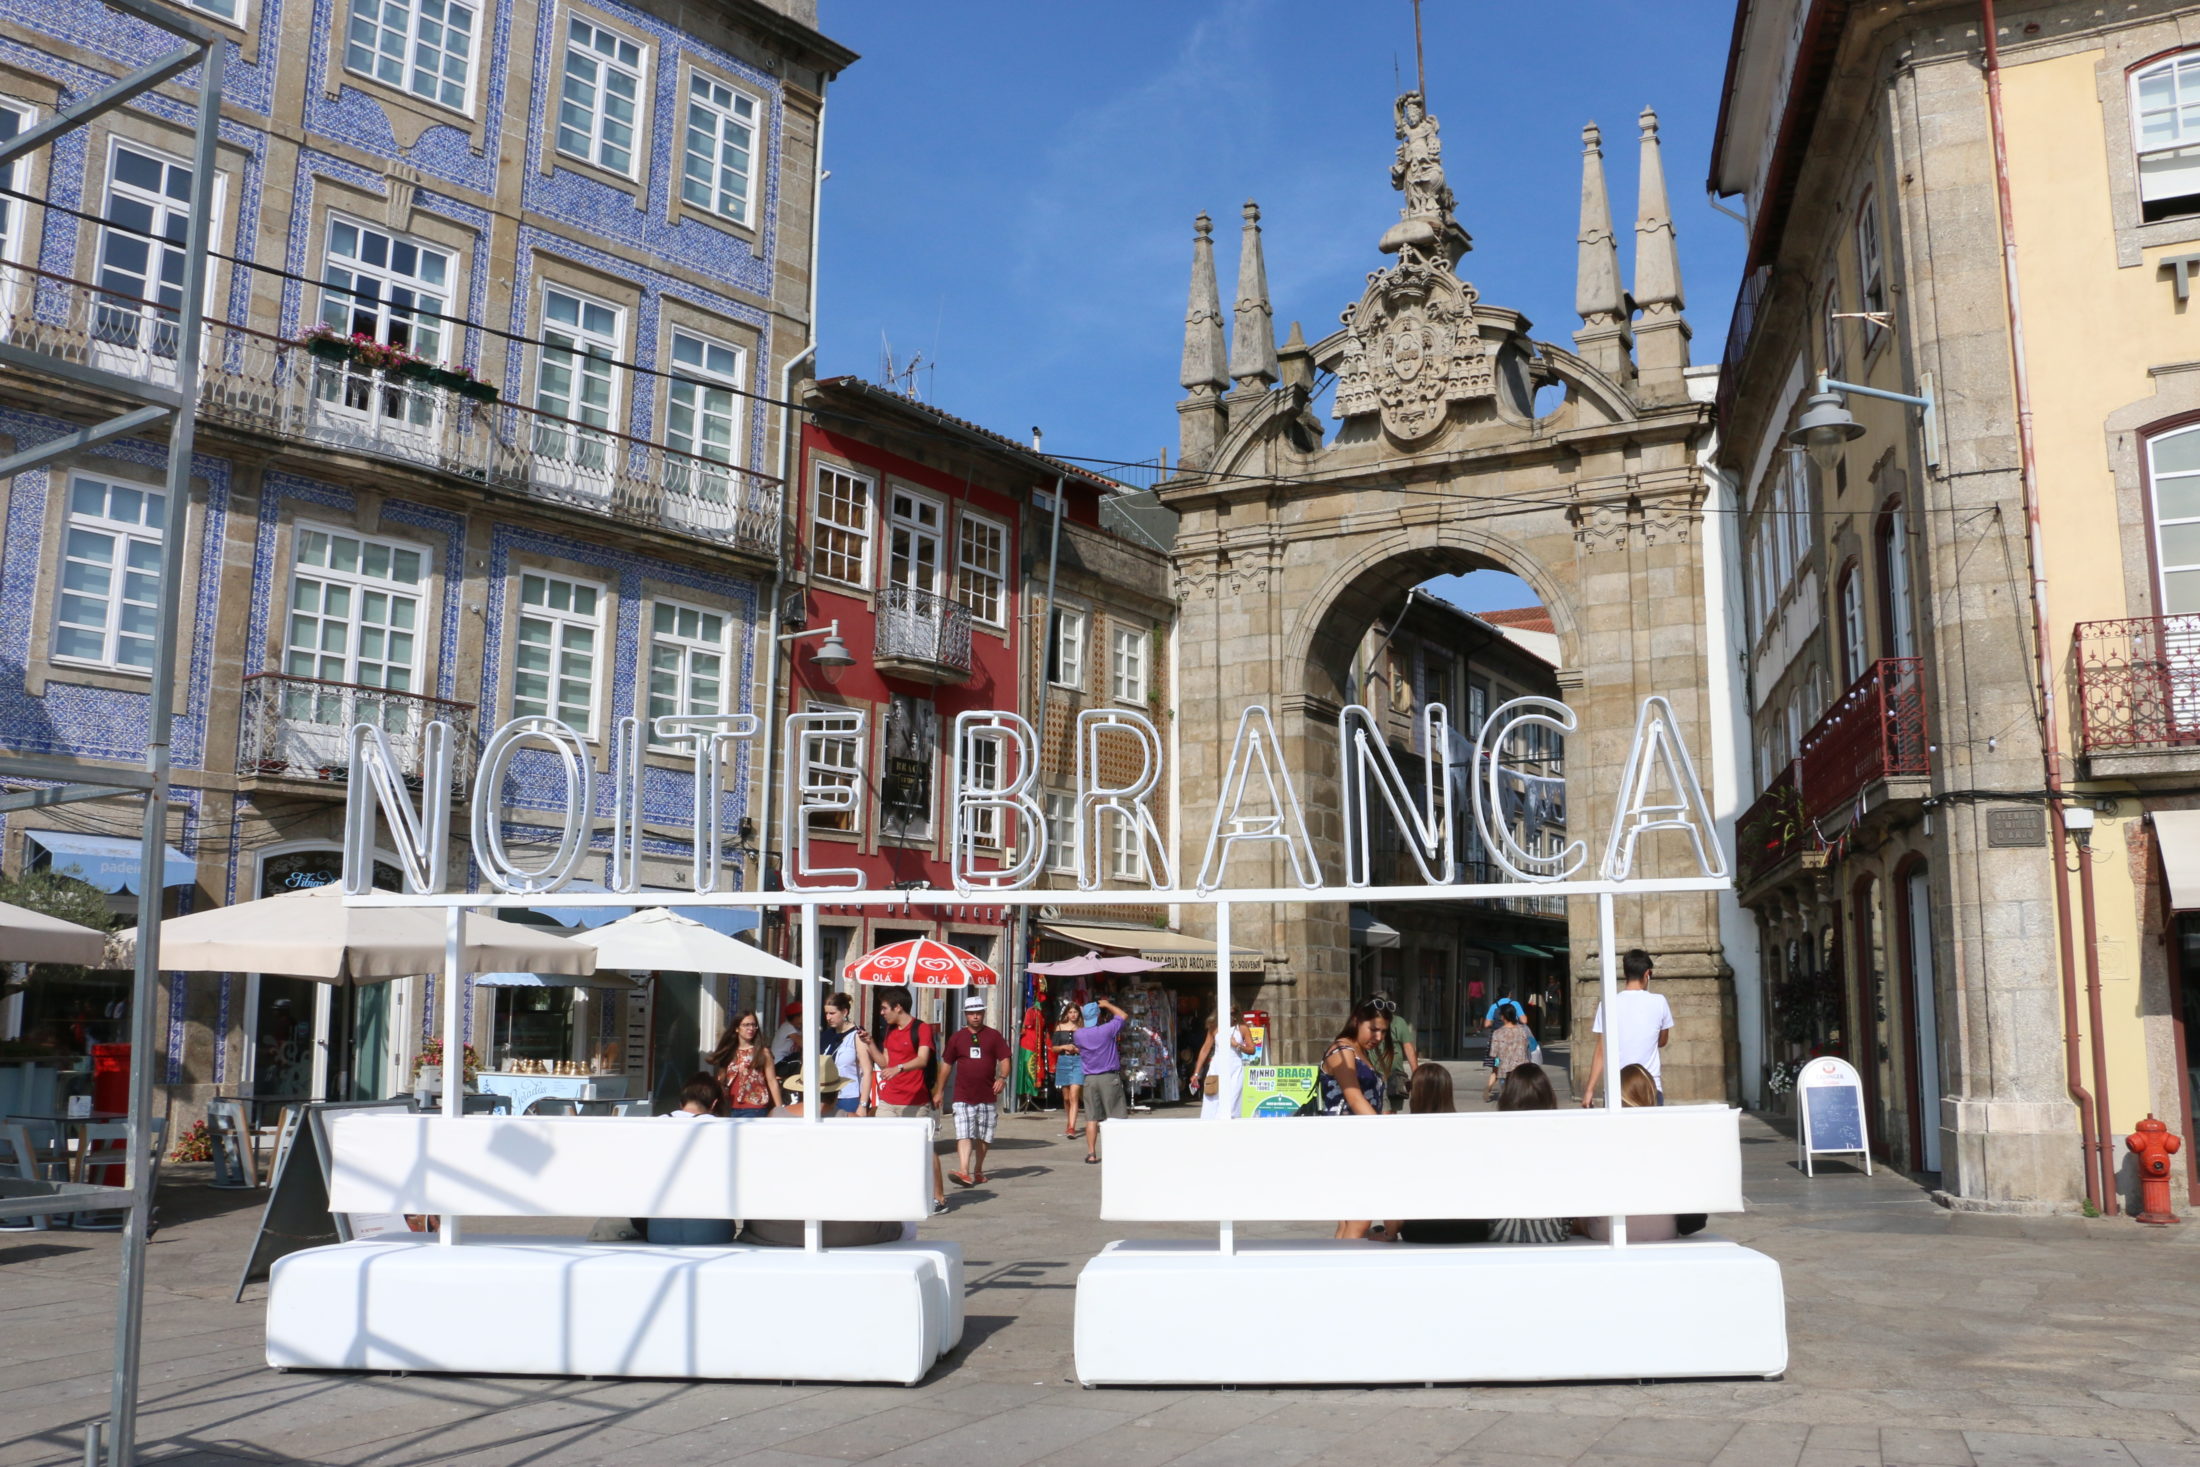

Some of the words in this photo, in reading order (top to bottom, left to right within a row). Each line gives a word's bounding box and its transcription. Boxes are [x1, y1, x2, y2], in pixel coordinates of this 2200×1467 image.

[342, 711, 867, 895] NOITE
[953, 695, 1728, 893] BRANCA
[2005, 821, 2038, 829] MIGUEL
[2008, 830, 2034, 839] ANJO
[1179, 956, 1188, 969] DO
[1189, 957, 1204, 969] ARCO
[872, 973, 892, 982] OLÁ
[926, 974, 950, 985] OLÁ
[1249, 1069, 1275, 1081] MINHO
[1277, 1068, 1312, 1078] BRAGA
